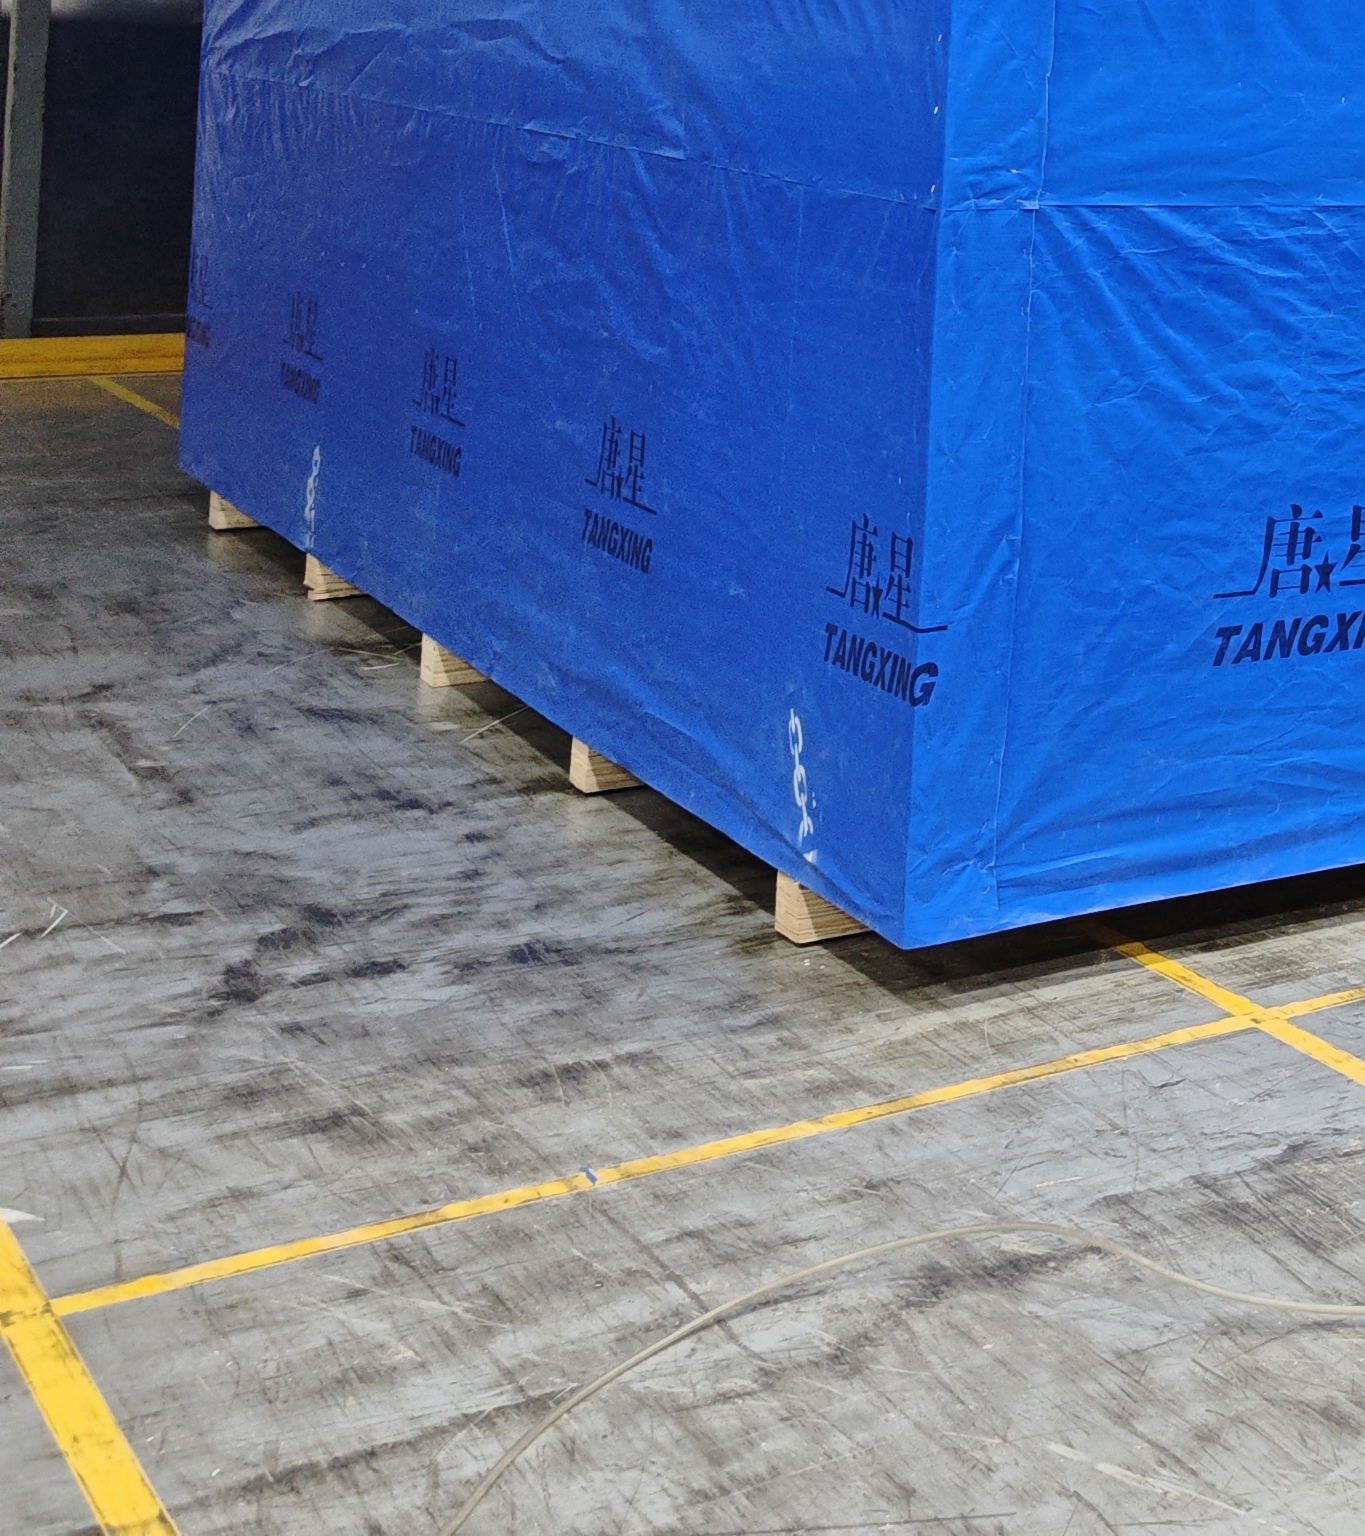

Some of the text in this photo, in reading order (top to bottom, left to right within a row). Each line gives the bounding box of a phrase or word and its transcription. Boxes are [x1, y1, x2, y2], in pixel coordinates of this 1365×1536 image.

[411, 345, 466, 427] 唐星
[410, 424, 462, 479] TANGXING
[585, 415, 657, 515] 唐星
[581, 508, 653, 574] TANGXING
[826, 513, 948, 633] 唐星
[824, 622, 938, 707] TANGXING
